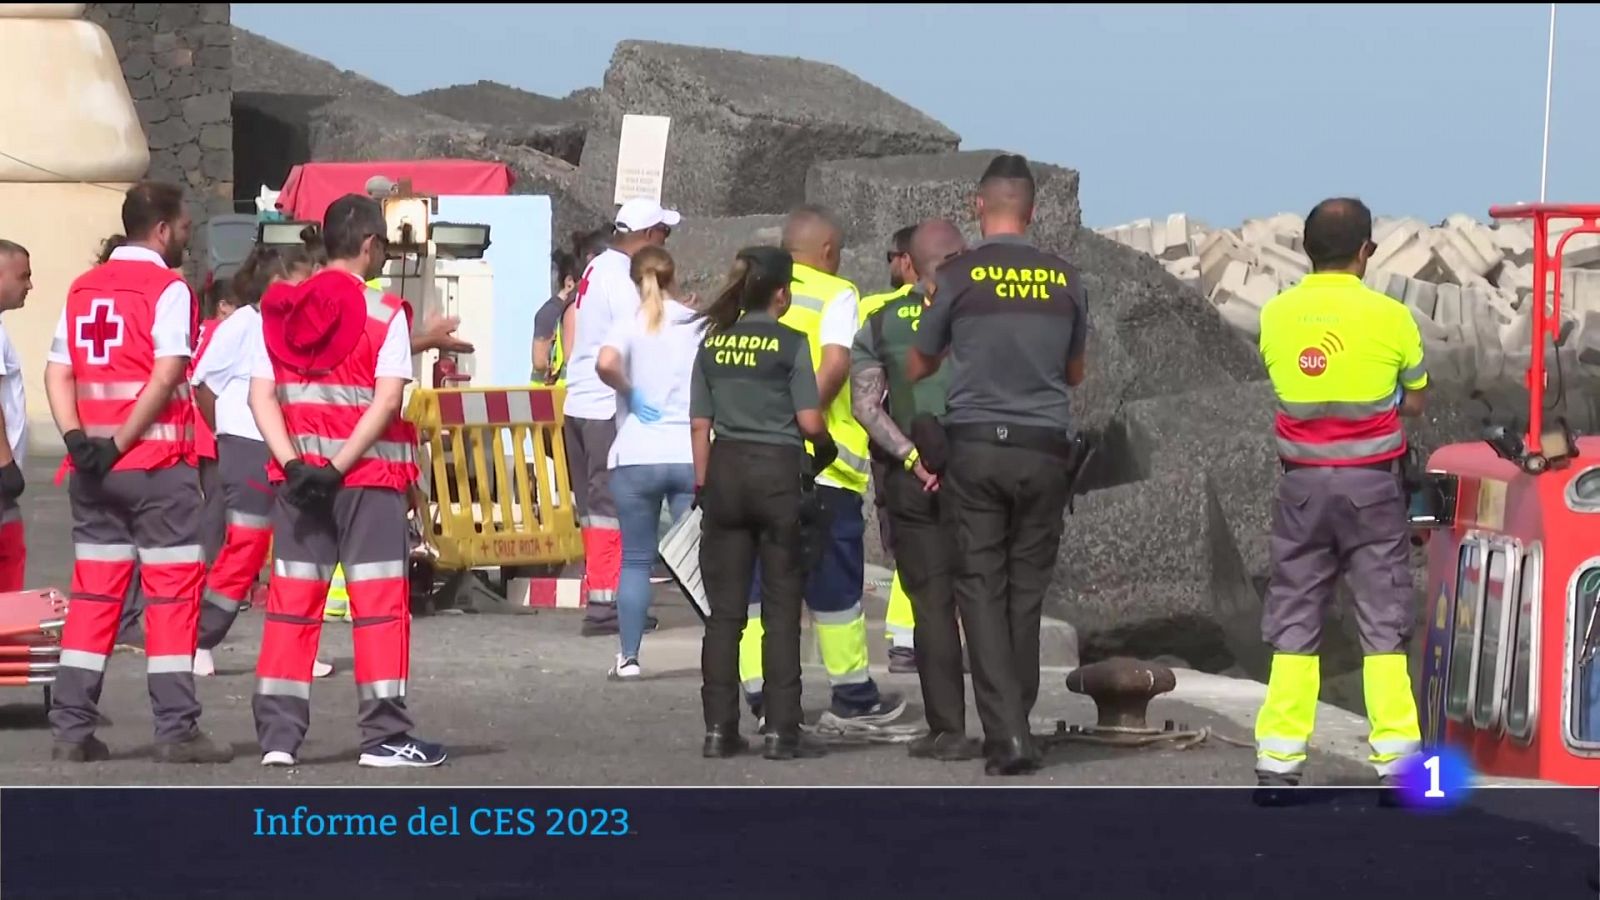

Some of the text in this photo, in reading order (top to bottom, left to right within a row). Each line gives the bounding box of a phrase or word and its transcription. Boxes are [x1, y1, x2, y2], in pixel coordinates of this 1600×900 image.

[970, 266, 1067, 287] GUARDIA
[995, 283, 1050, 299] CIVIL
[704, 334, 779, 352] GUARDIA
[715, 350, 757, 366] CIVIL
[1299, 355, 1326, 368] SUC
[493, 538, 516, 557] CRUZ
